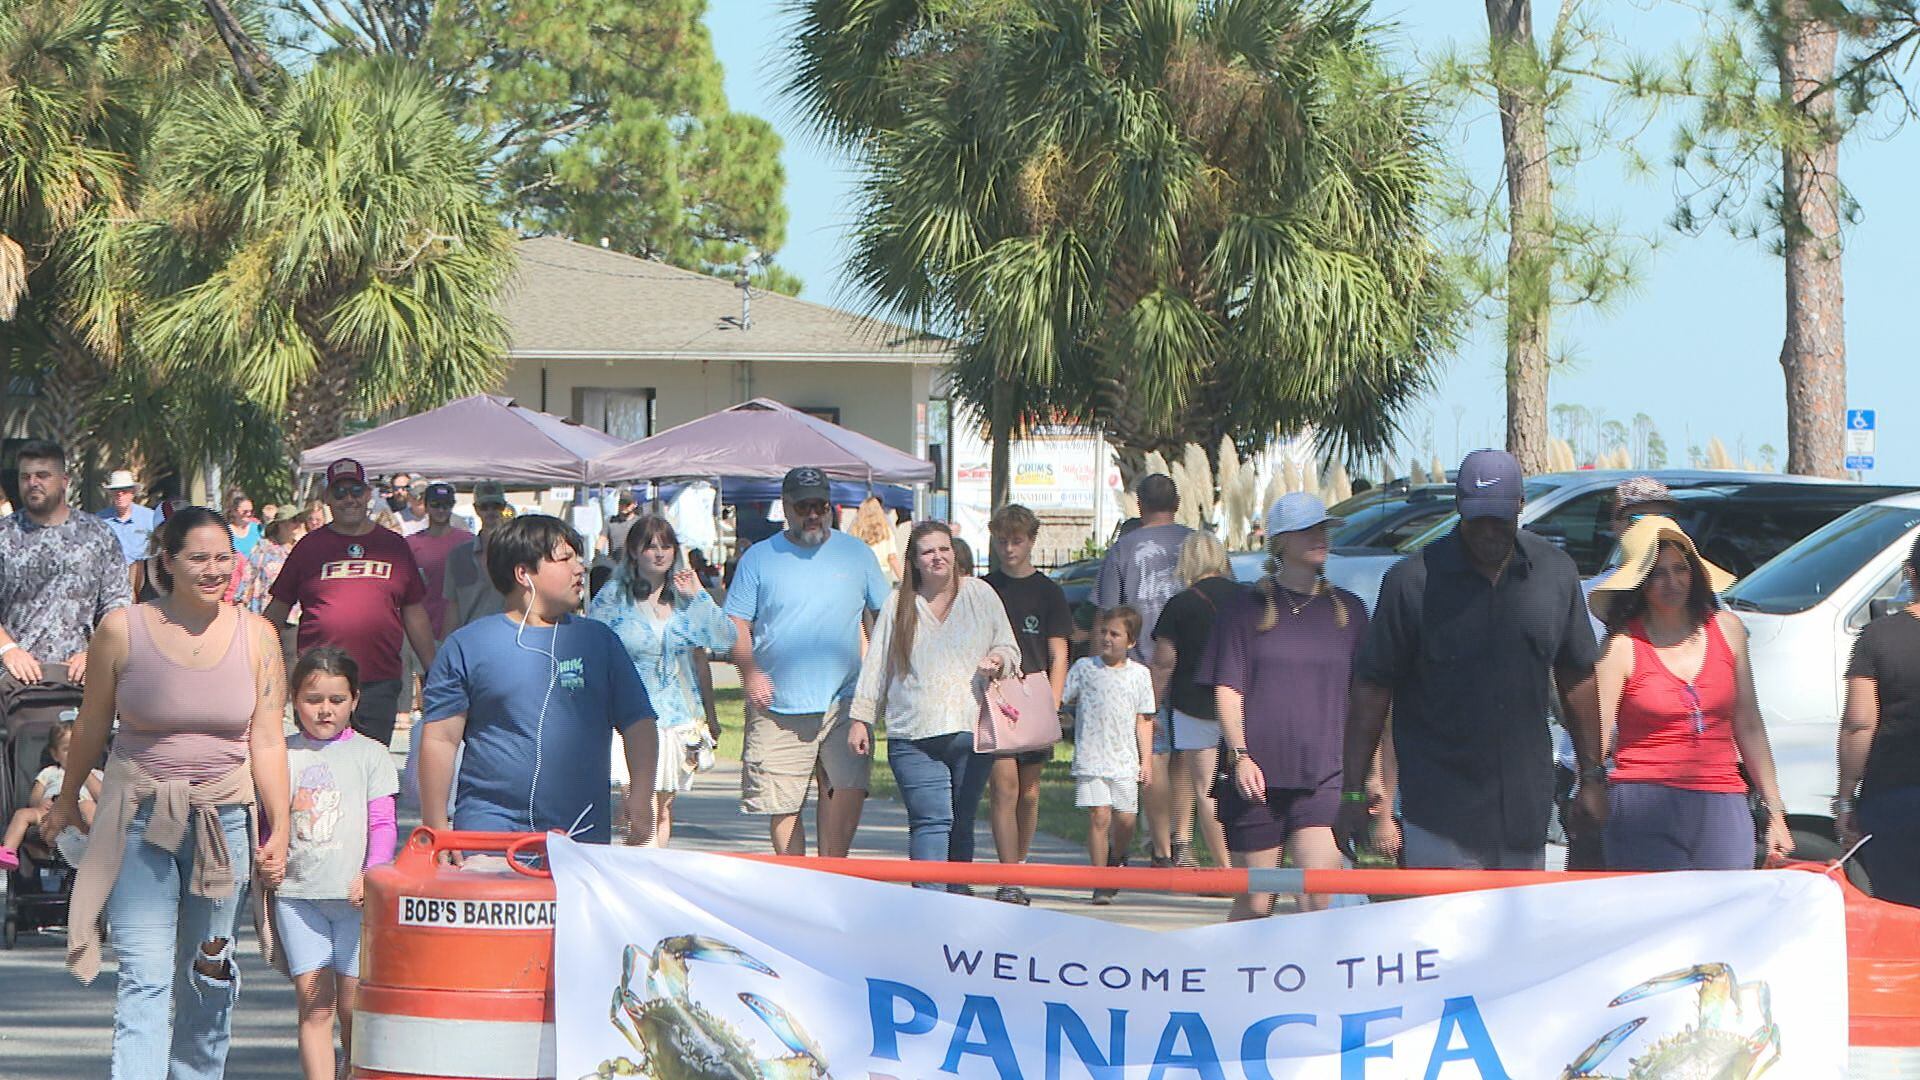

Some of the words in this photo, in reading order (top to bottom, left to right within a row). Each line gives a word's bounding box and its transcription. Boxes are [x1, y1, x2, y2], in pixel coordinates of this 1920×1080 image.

[1016, 463, 1054, 476] CRUM'S
[322, 560, 392, 580] FSU
[405, 898, 457, 923] BOB'S
[943, 943, 1207, 993] WELCOME
[1237, 963, 1306, 993] TO
[1336, 948, 1440, 989] THE
[865, 977, 1512, 1080] PANACEA
